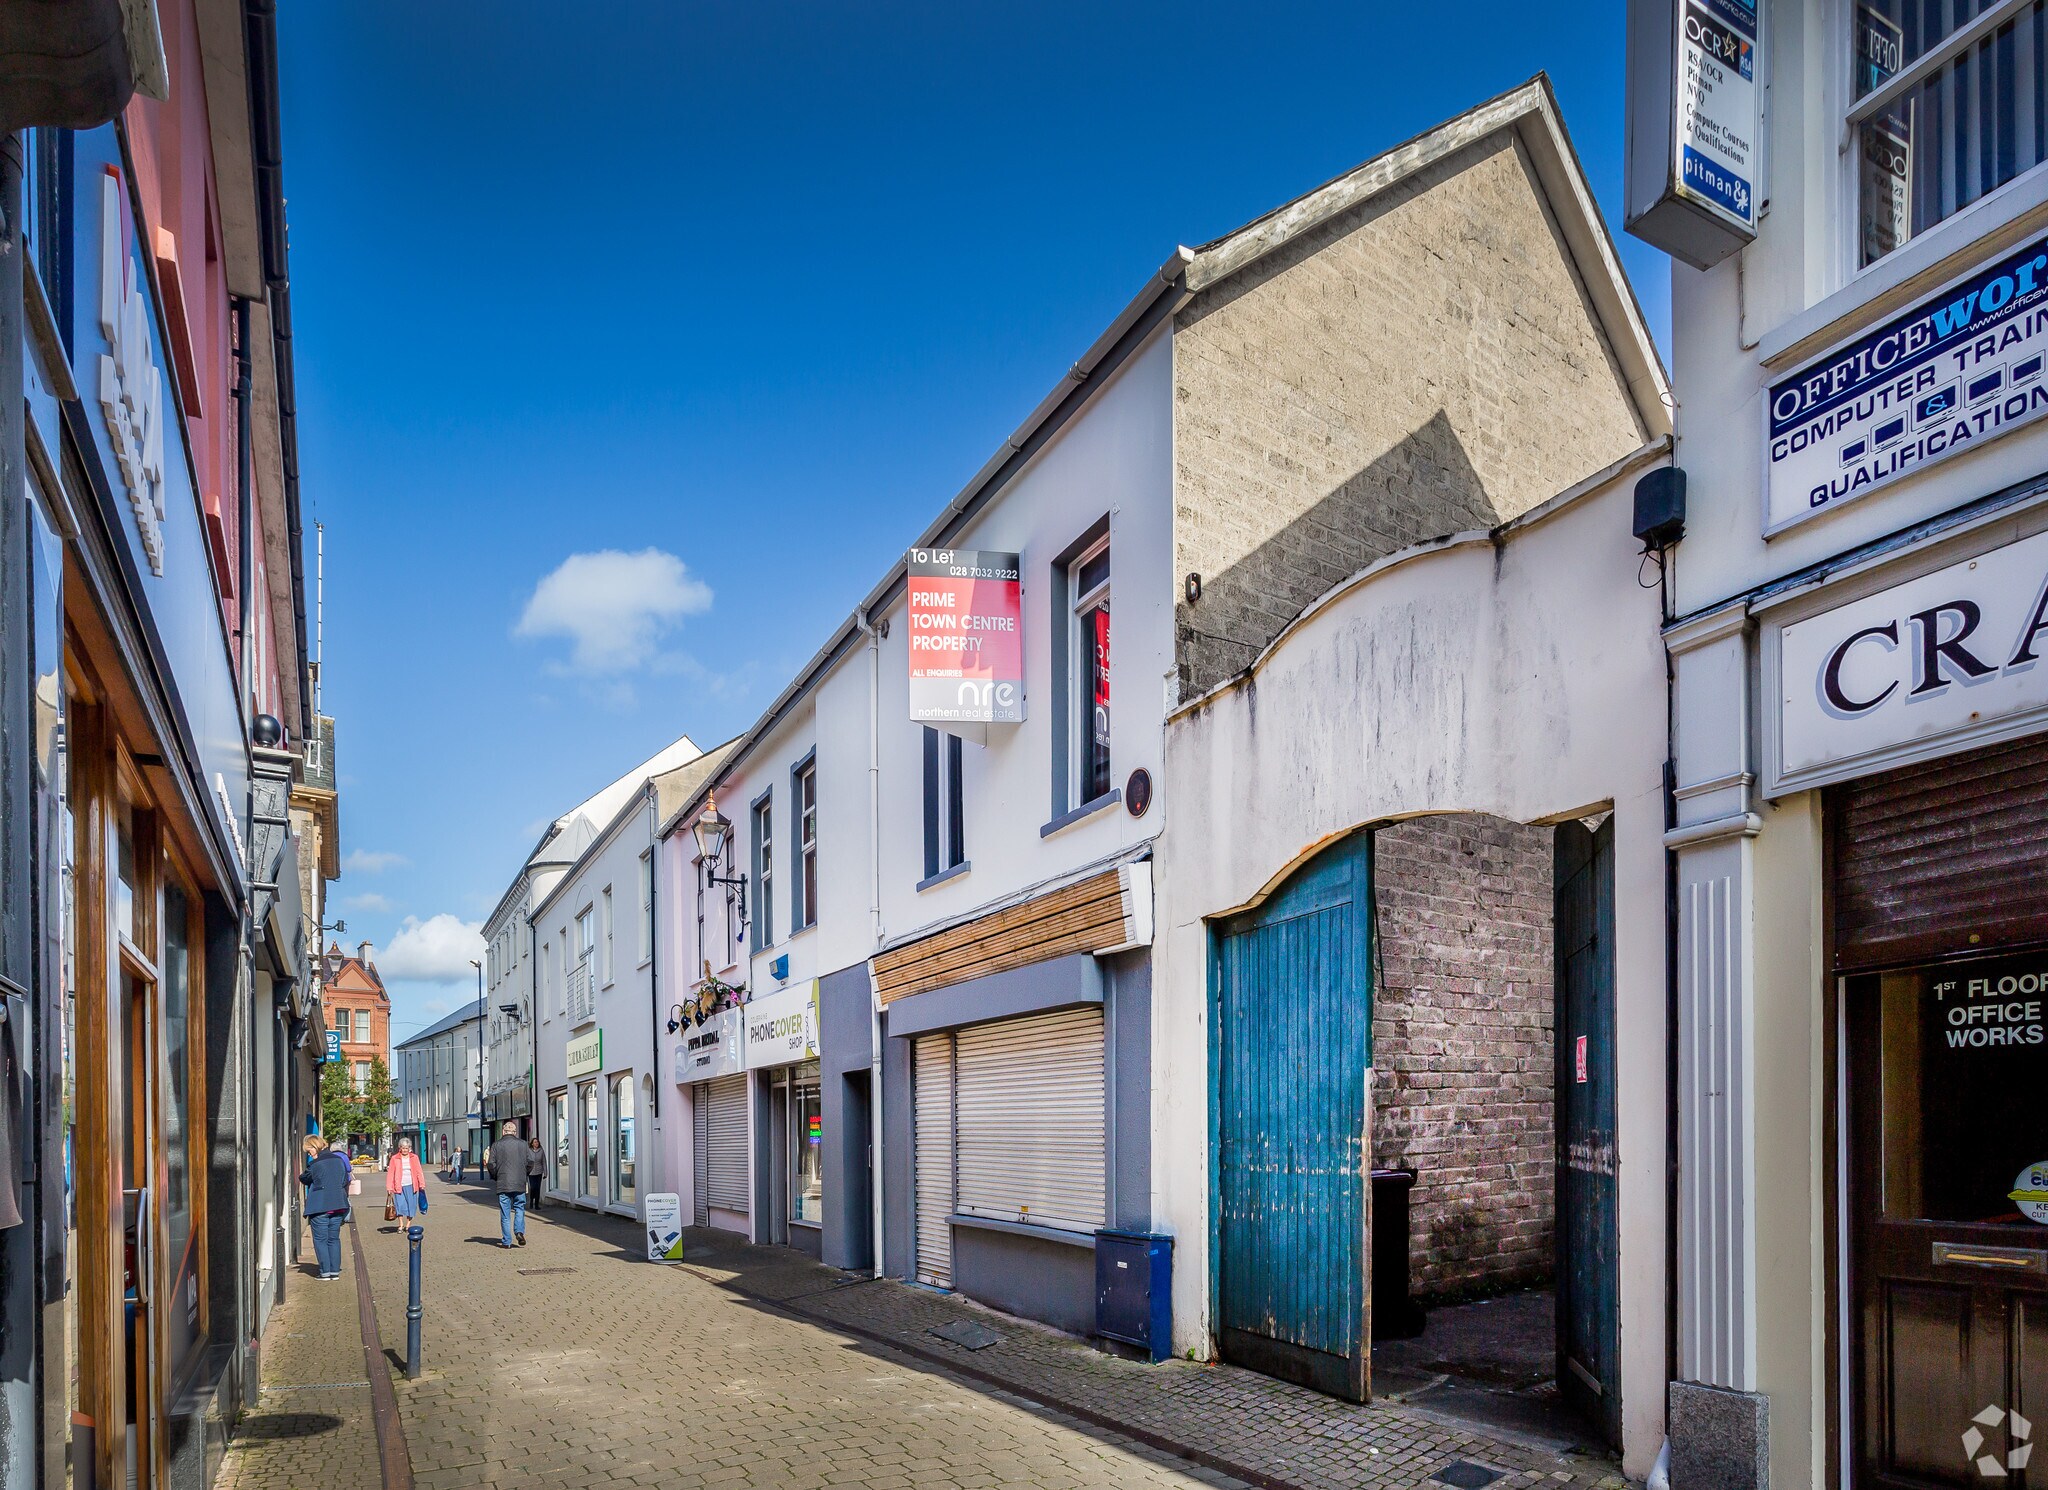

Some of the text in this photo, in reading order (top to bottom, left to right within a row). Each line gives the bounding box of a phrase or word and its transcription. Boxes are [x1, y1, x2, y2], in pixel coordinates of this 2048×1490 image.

[1685, 15, 1722, 58] OCR
[1687, 49, 1724, 85] RSA/OCR
[1687, 66, 1713, 94] Pitman
[1687, 82, 1705, 107] NVQ
[1686, 103, 1750, 152] Computer Courses
[1686, 119, 1745, 166] & Qualifications
[1773, 240, 2048, 421] OFFICEwor
[1772, 364, 1935, 463] COMPUTER
[1925, 394, 1948, 416] &
[911, 549, 954, 565] To Let
[950, 566, 1018, 579] 028 7032 9222
[912, 592, 956, 607] PRIME
[912, 614, 1014, 631] TOWN CENTRE
[913, 636, 983, 651] PROPERTY
[912, 669, 962, 677] ALL ENQUIRIES
[958, 681, 1014, 707] nre
[919, 707, 1014, 718] northern real estate
[1933, 981, 1957, 1000] 1ST
[1948, 1001, 2041, 1026] OFFICE
[789, 1036, 803, 1049] SHOP
[1945, 1024, 2044, 1048] WORKS
